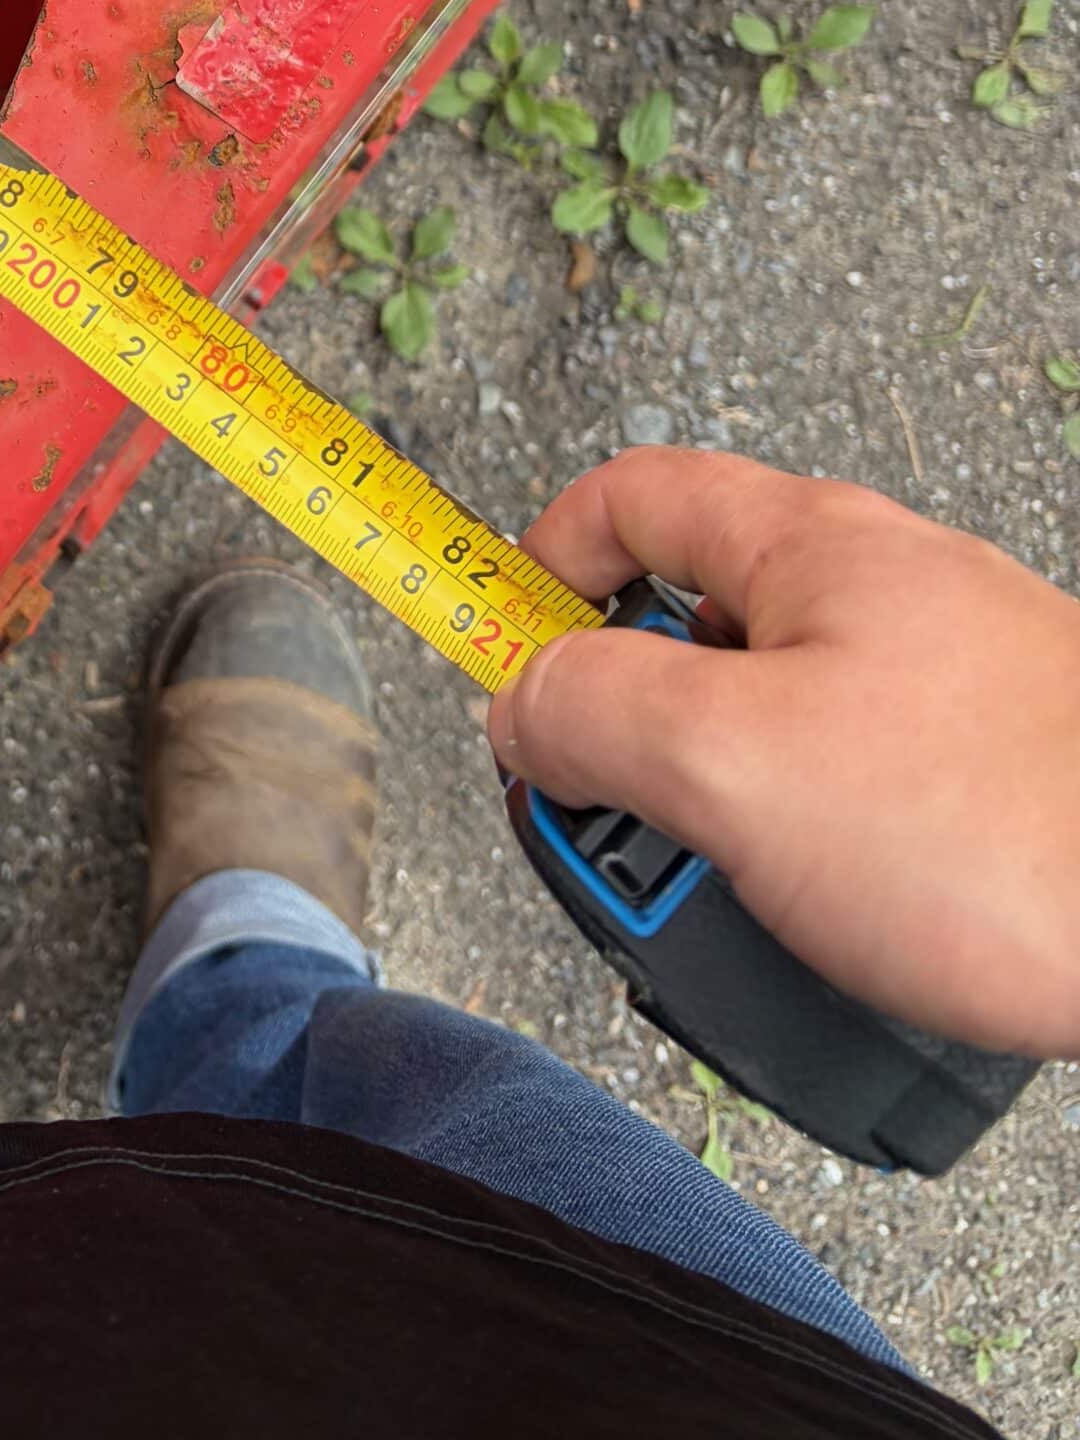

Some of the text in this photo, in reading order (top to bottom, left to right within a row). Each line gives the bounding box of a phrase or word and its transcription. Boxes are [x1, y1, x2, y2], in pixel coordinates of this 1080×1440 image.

[79, 303, 103, 330] 1
[115, 335, 147, 368] 2
[165, 372, 192, 403] 3
[209, 412, 238, 440] 4
[257, 446, 288, 478] 5
[305, 485, 333, 517] 6
[353, 520, 384, 552] 7
[400, 563, 429, 596] 8
[448, 602, 476, 634] 9
[469, 618, 525, 673] 21
[86, 245, 141, 299] 79
[199, 339, 252, 394] 80
[320, 437, 376, 489] 81
[441, 535, 502, 591] 82
